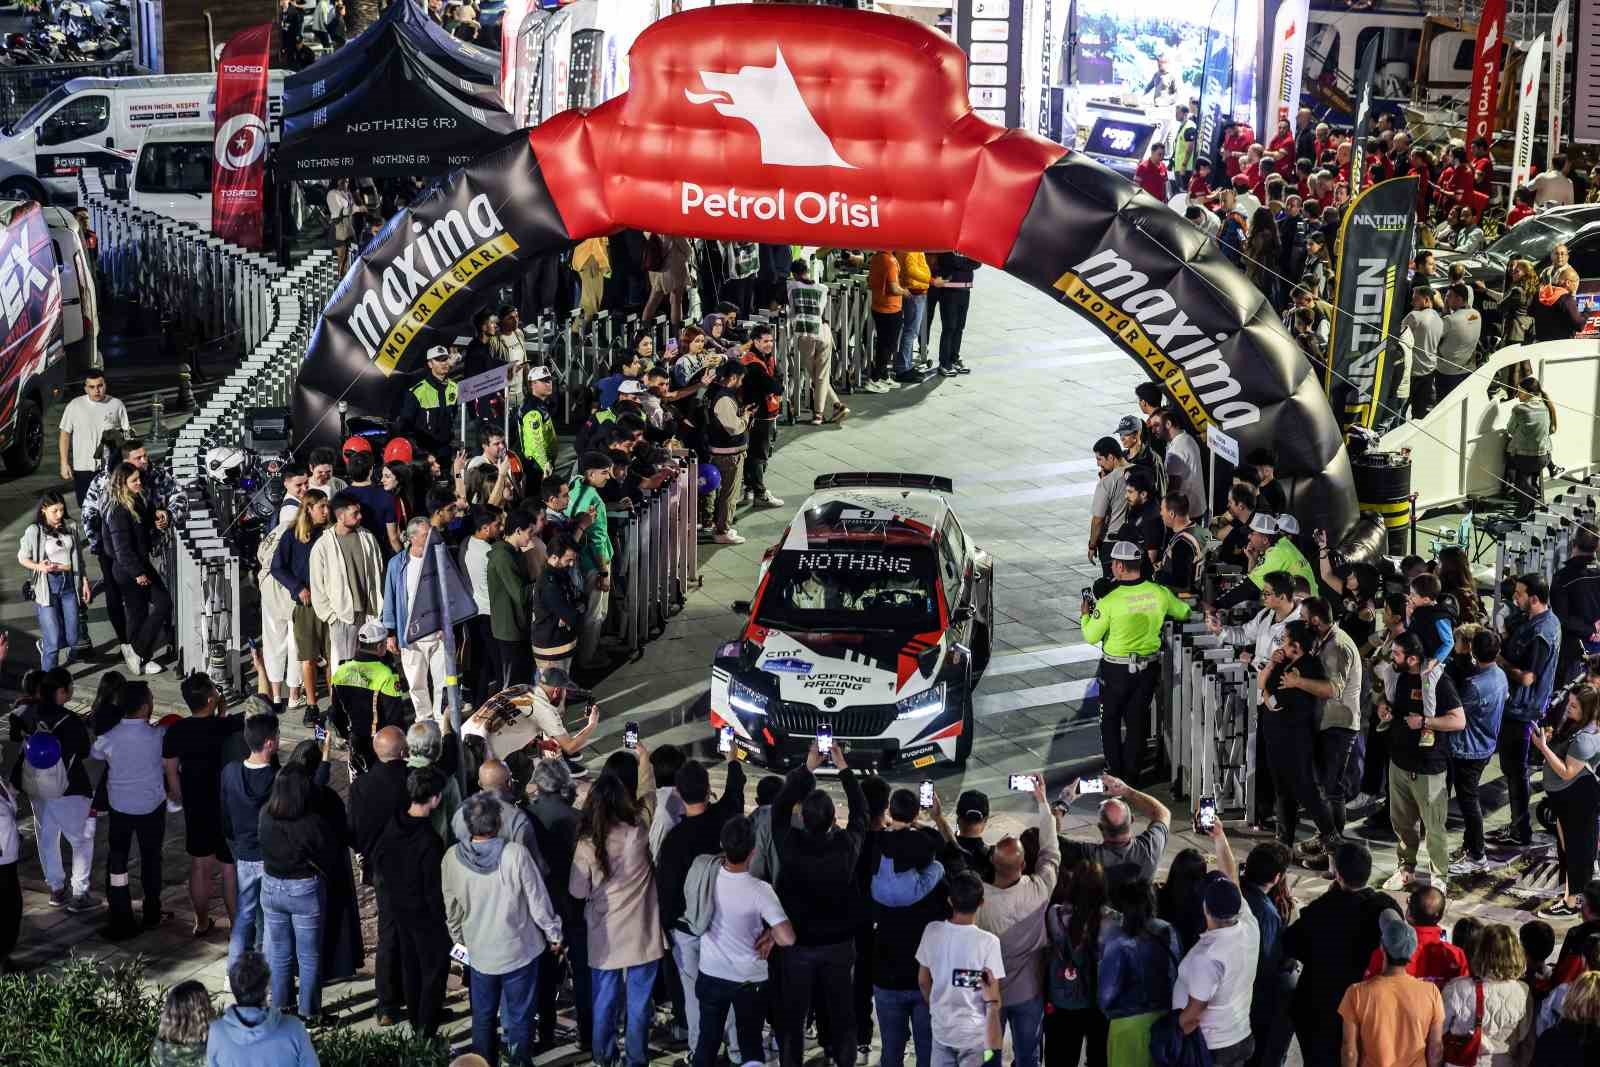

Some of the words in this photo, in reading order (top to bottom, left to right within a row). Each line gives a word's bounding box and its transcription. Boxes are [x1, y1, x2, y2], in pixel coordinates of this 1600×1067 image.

[1477, 62, 1494, 115] Petrol
[347, 118, 429, 133] NOTHING
[433, 118, 457, 129] (R)
[297, 158, 341, 168] NOTHING
[372, 154, 416, 165] NOTHING
[681, 181, 785, 220] Petrol
[794, 191, 880, 228] Ofisi
[1353, 214, 1407, 226] NATION
[348, 193, 504, 359] maxima
[1073, 287, 1139, 344] MOTOR
[385, 303, 432, 359] MOTOR
[1072, 249, 1260, 430] maxima
[860, 510, 875, 518] 9
[798, 553, 911, 573] NOTHING
[796, 673, 872, 683] EVOFONE
[804, 680, 863, 690] RACING
[901, 746, 934, 759] EVOFONE
